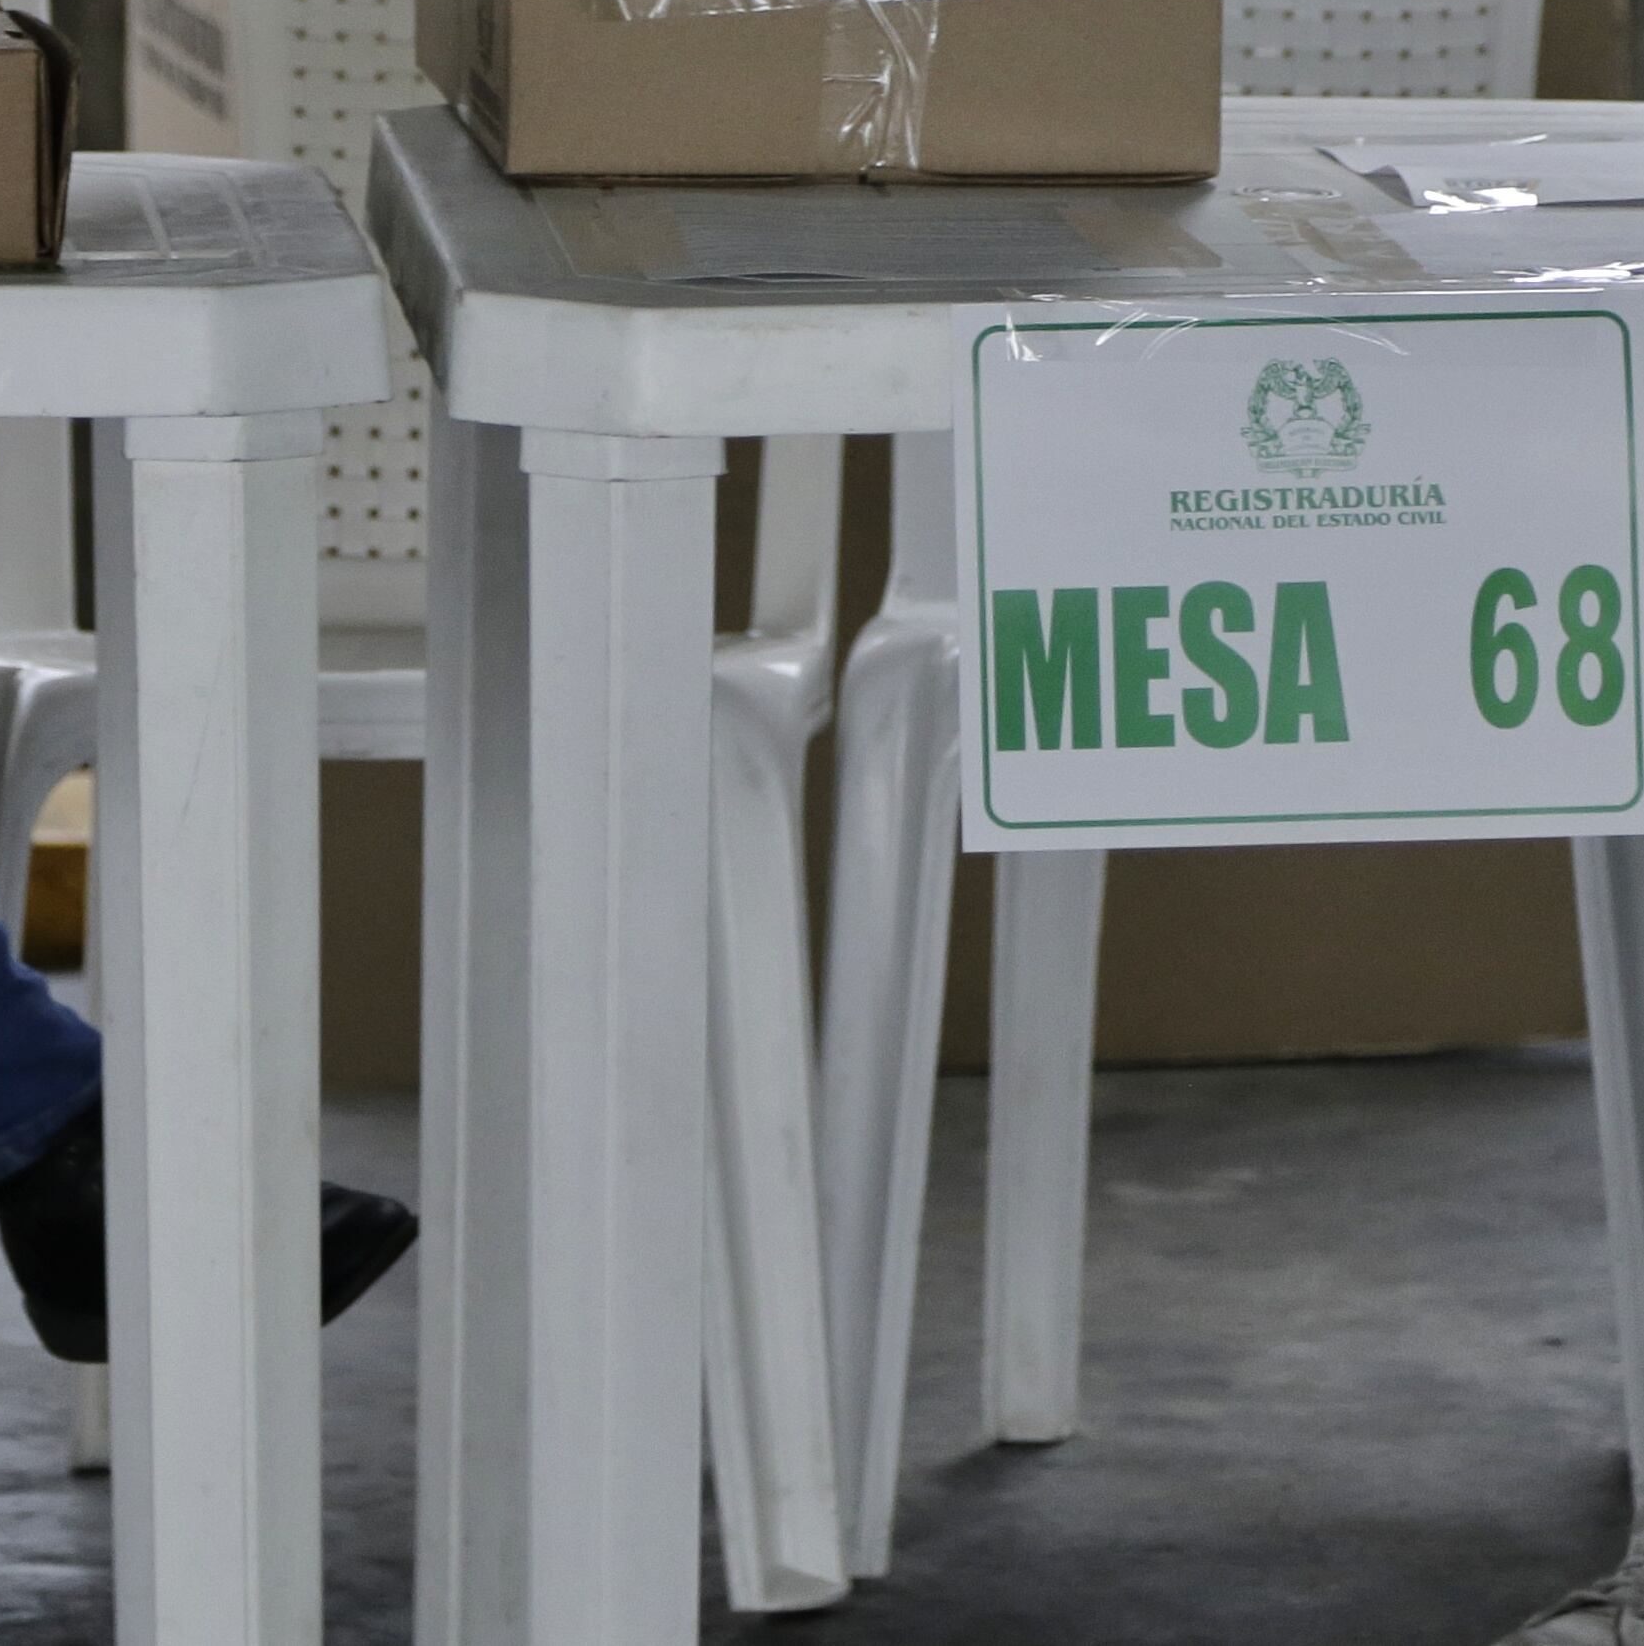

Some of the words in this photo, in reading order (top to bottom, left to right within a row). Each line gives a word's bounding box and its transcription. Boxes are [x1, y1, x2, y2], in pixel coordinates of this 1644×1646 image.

[1169, 476, 1447, 514] REGISTRADURÍA
[1170, 516, 1266, 531] NACIONAL
[1272, 514, 1310, 529] DEL
[1316, 512, 1392, 528] ESTADO
[1397, 510, 1447, 526] CIVIL
[991, 580, 1351, 752] MESA
[1469, 563, 1625, 730] 68
